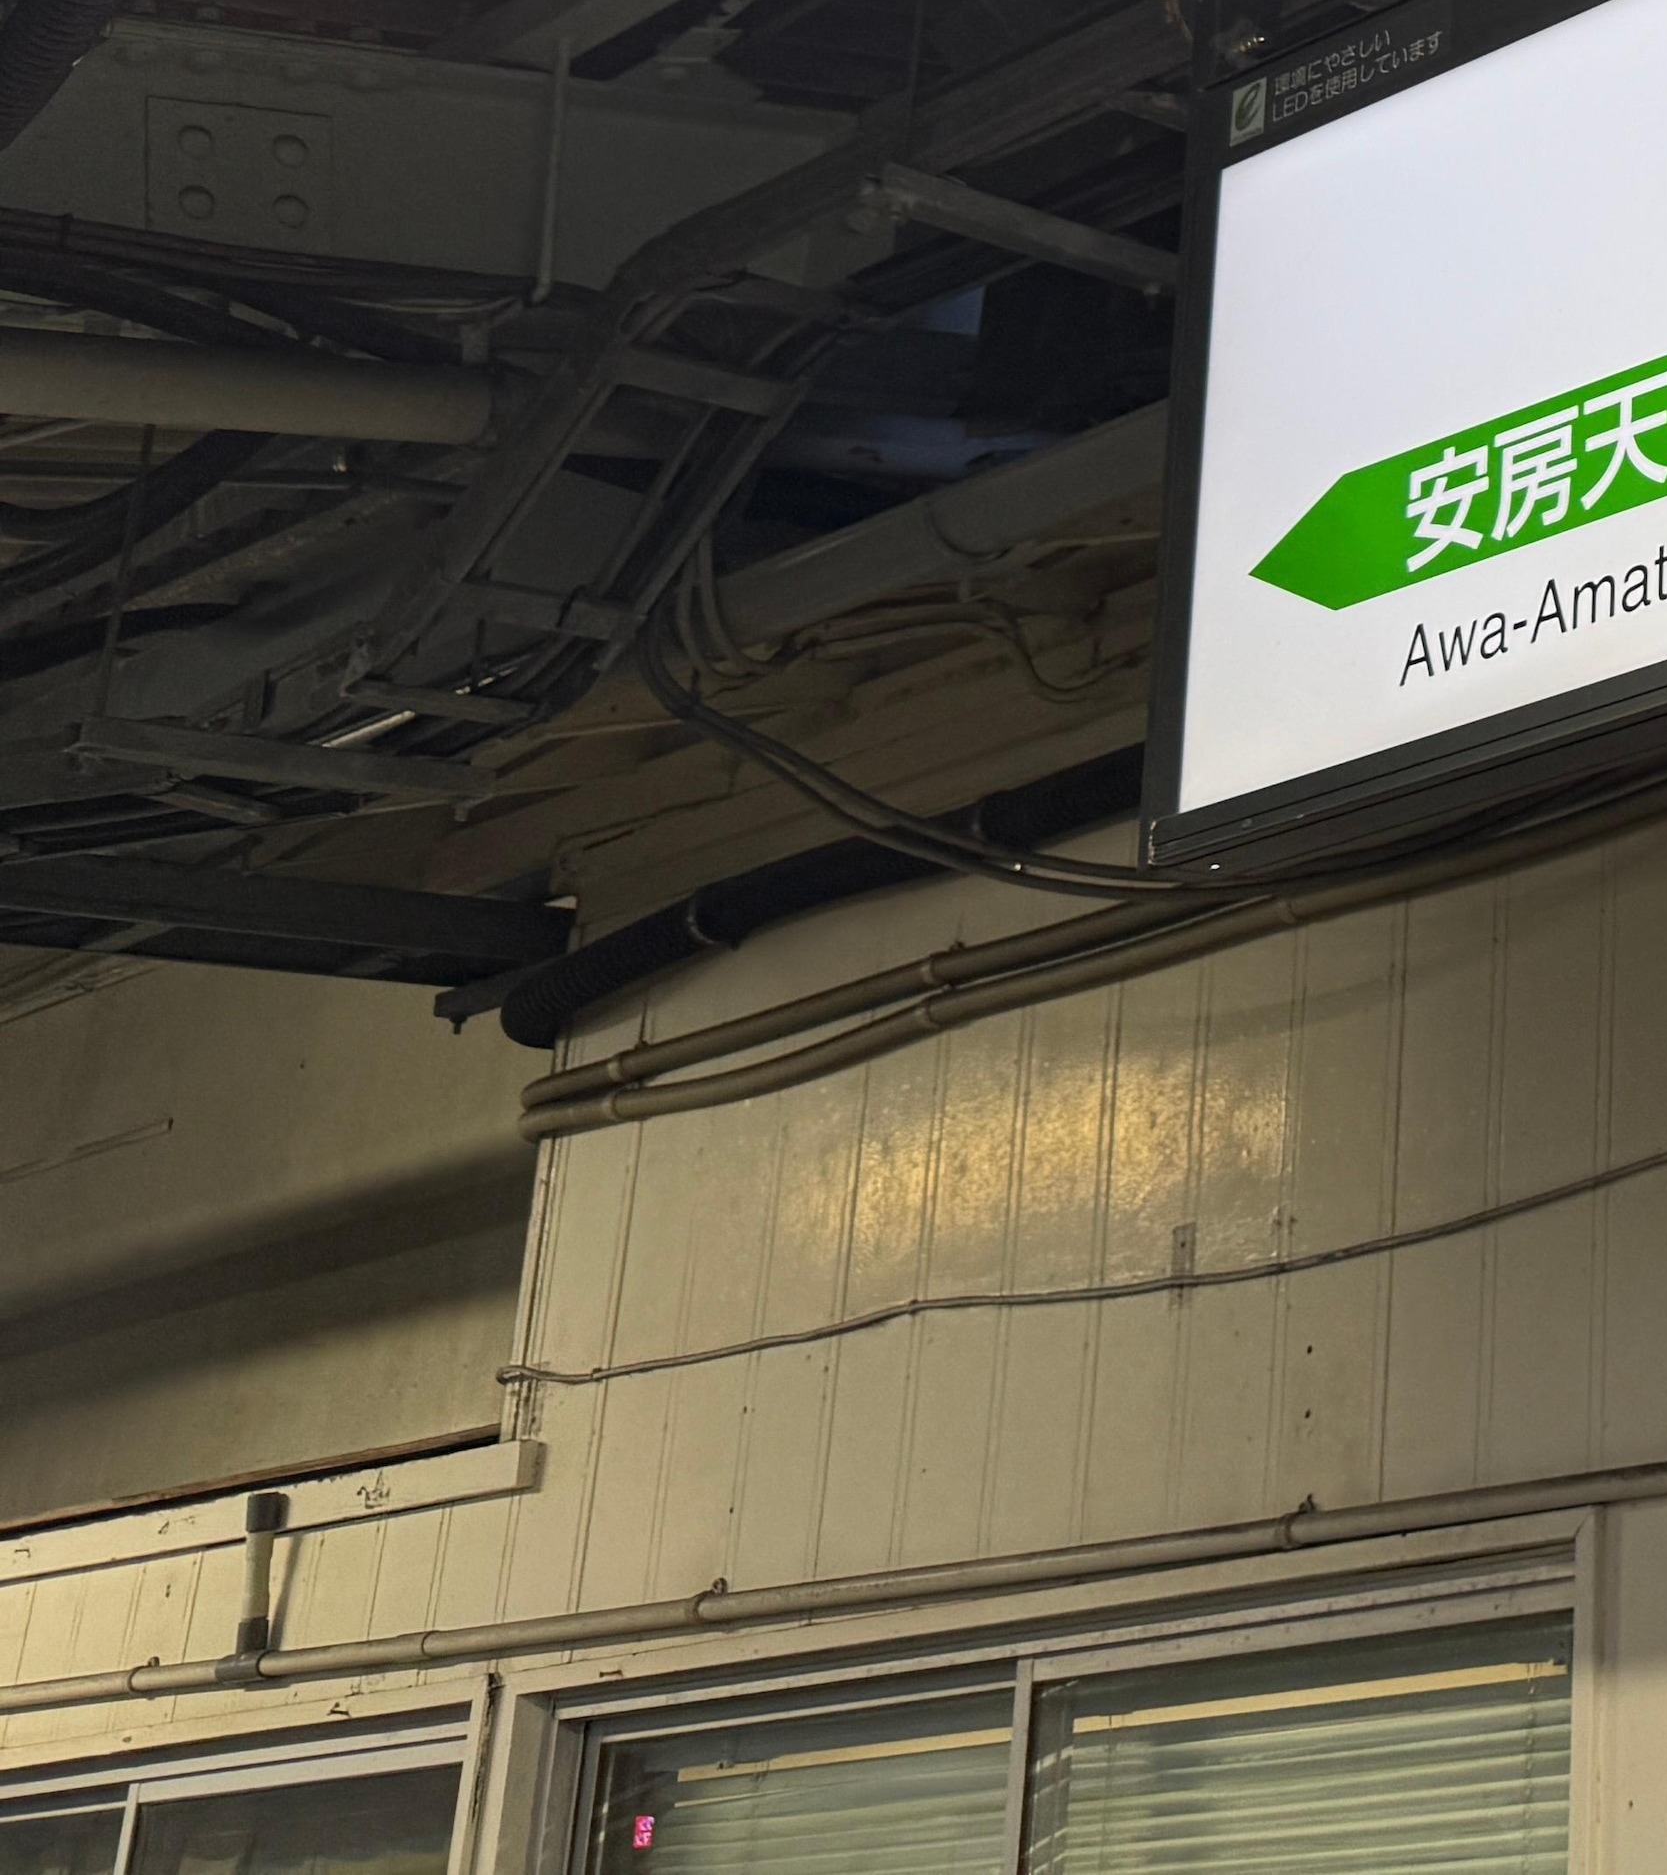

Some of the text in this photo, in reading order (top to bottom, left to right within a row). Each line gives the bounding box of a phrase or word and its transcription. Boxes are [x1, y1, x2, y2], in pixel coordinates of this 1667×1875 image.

[1271, 29, 1443, 123] LEDを使用しています
[1273, 29, 1391, 96] 環境にやさしい
